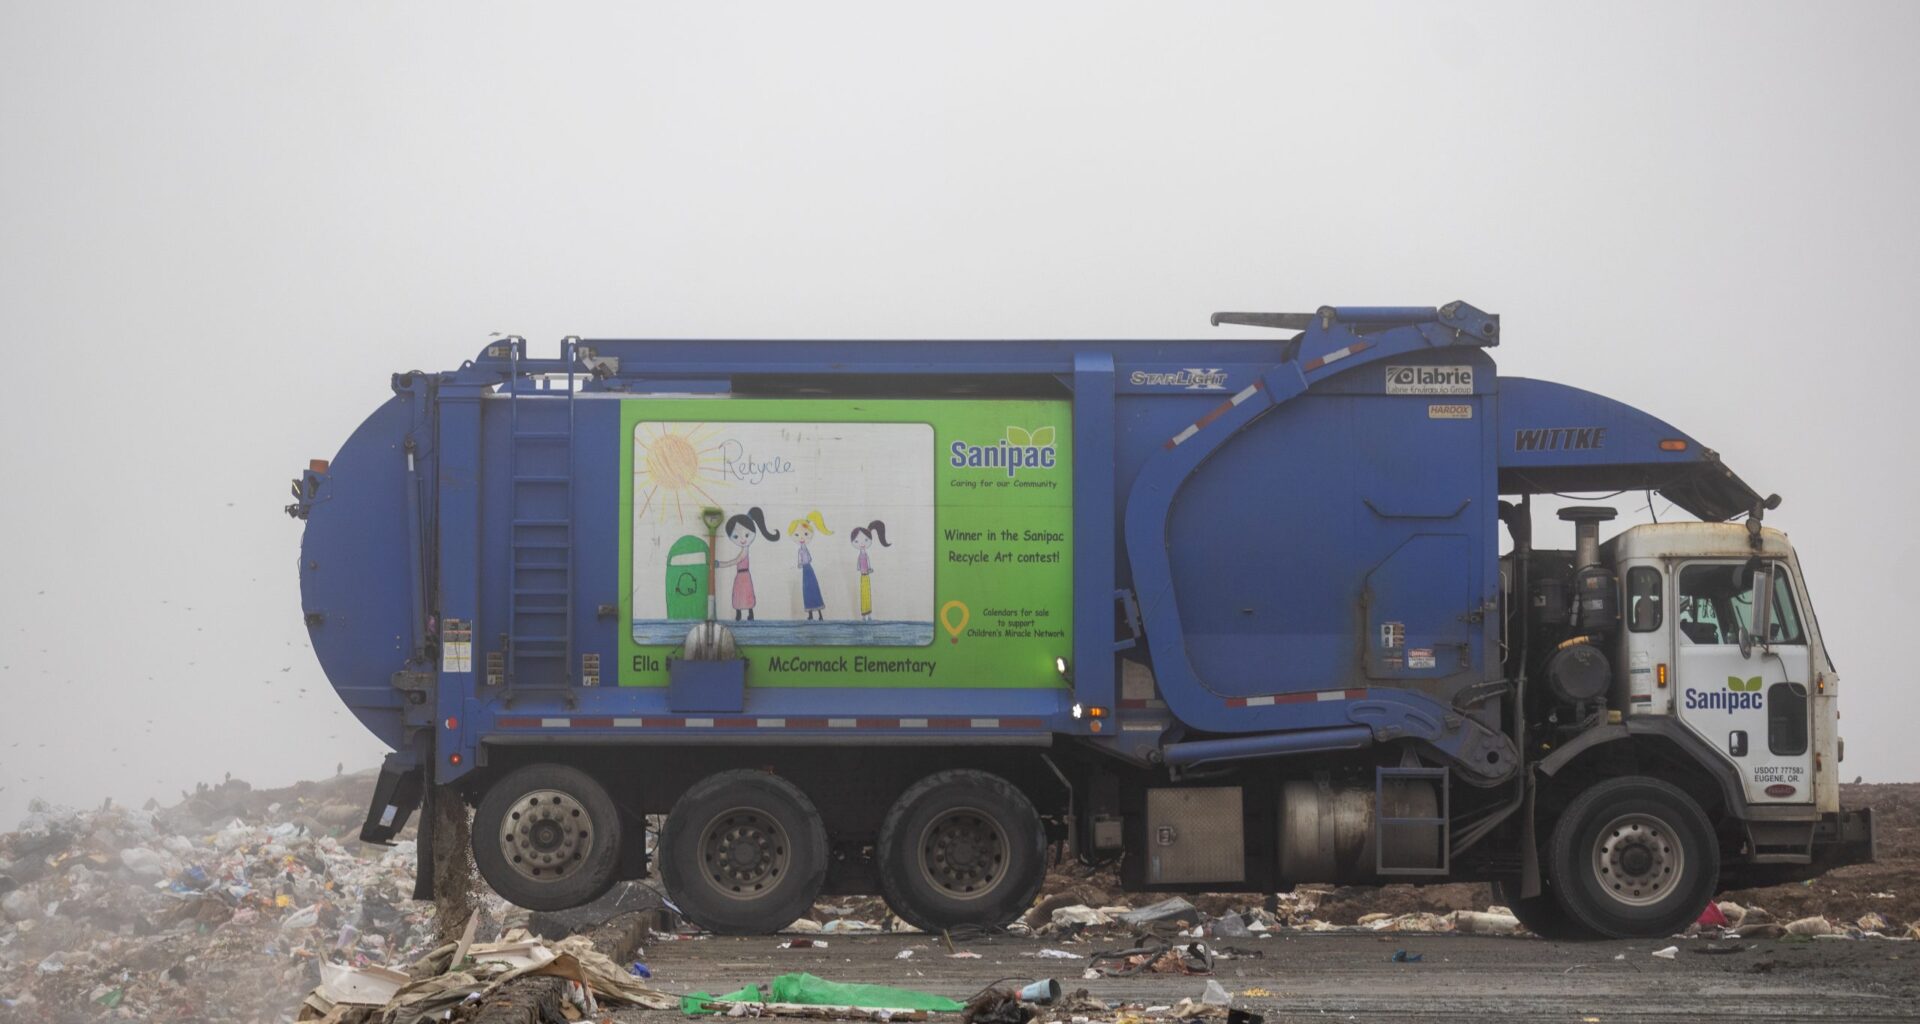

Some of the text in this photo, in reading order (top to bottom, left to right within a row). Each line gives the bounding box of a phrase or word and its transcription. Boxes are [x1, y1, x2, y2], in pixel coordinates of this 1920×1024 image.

[1417, 368, 1471, 384] labrie
[1450, 386, 1471, 394] Group
[1430, 406, 1469, 414] HARDOX
[1515, 427, 1608, 451] WITTKE
[950, 439, 1056, 477] Sanipac
[950, 480, 977, 489] Caring
[1013, 480, 1057, 489] Community
[944, 529, 1064, 544] Winner in the Sanipac
[948, 550, 1060, 566] Recycle Art contest!
[983, 608, 1049, 617] Calendars for sale
[1008, 620, 1035, 629] support
[967, 629, 1065, 637] Children's Miracle Network
[633, 656, 659, 672] Ella
[768, 656, 848, 672] McCornack
[854, 656, 937, 677] Elementary
[1685, 687, 1762, 714] Sanipac
[1754, 766, 1778, 774] USDOT
[1754, 775, 1786, 783] EUGENE,
